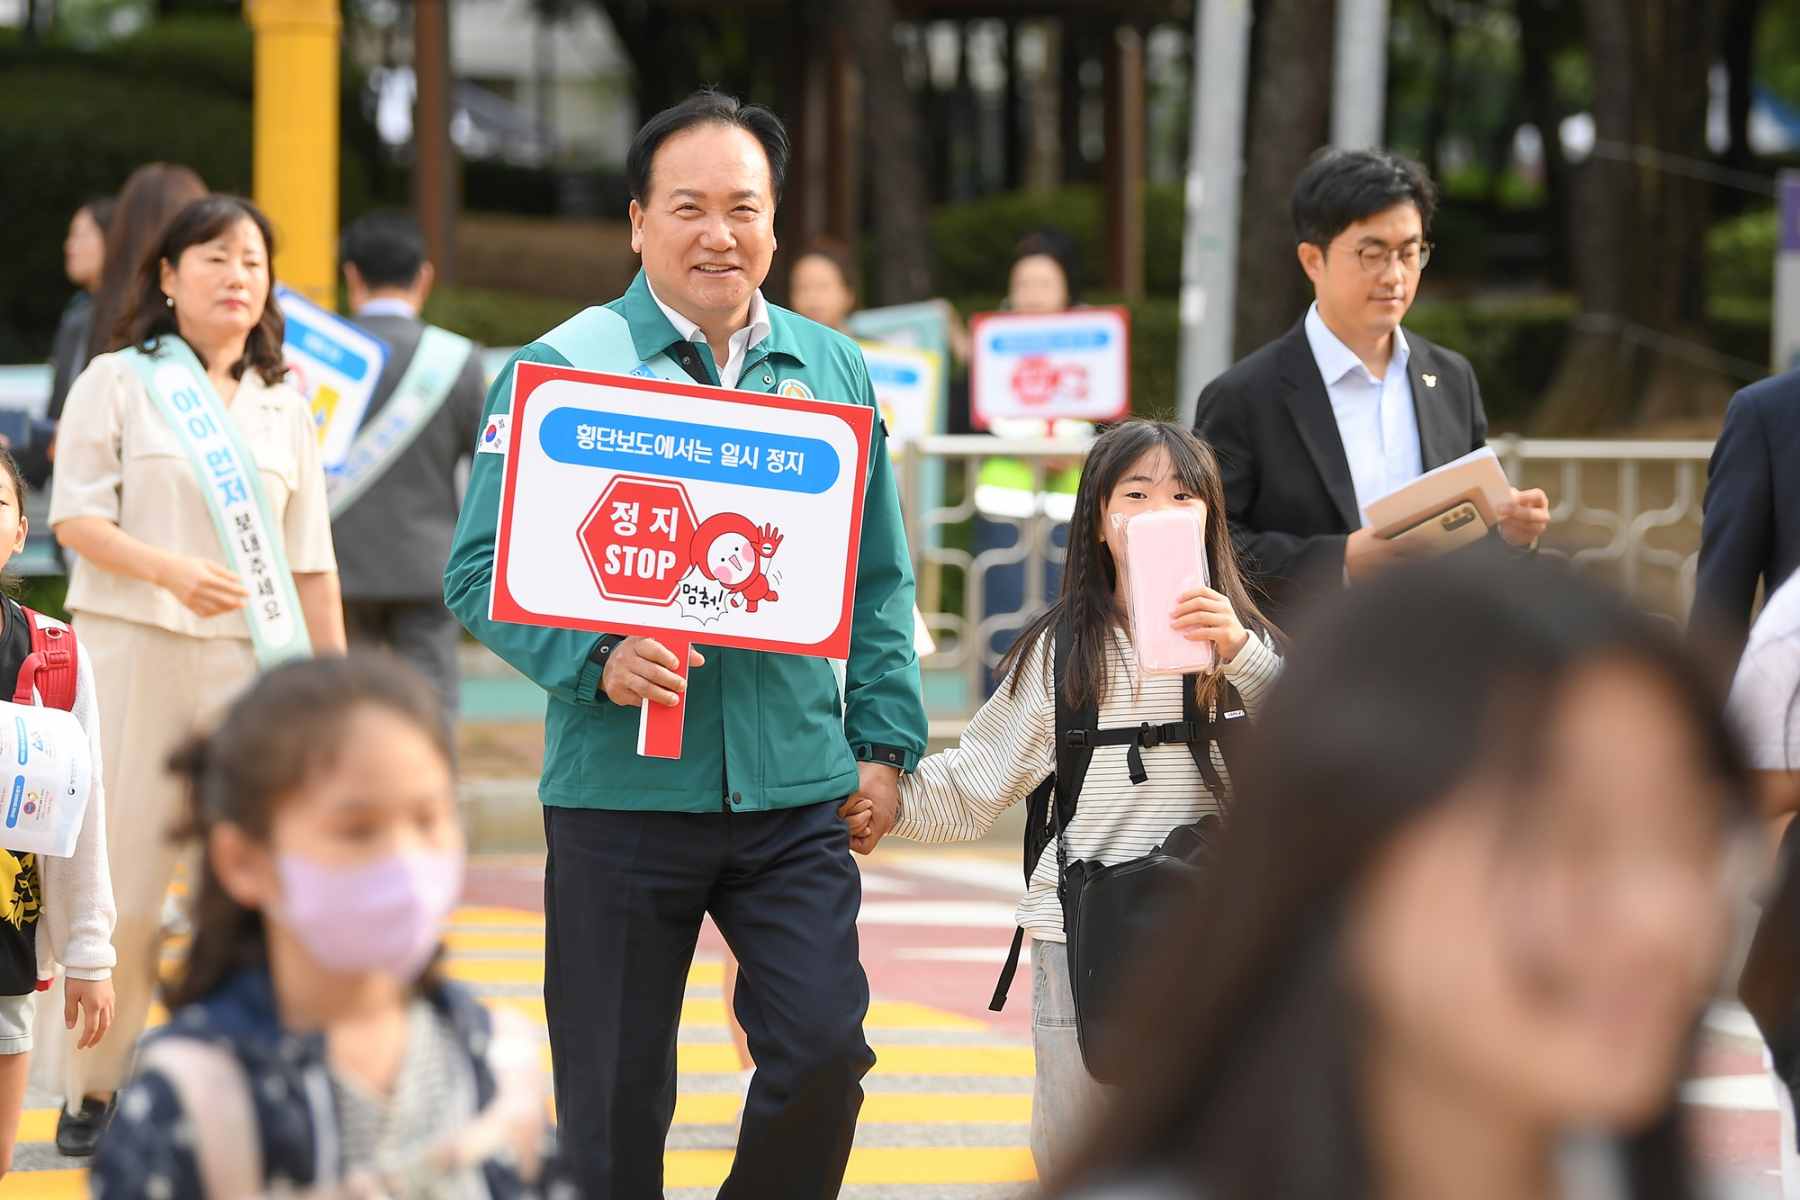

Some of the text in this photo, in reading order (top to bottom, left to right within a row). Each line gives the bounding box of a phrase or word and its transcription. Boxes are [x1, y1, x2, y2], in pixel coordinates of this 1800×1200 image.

[576, 423, 805, 476] 횡단보도에서는 일시 정지
[171, 386, 281, 621] 아이 먼저 보내주세요
[604, 544, 677, 581] STOP
[682, 583, 724, 611] 멈춰!
